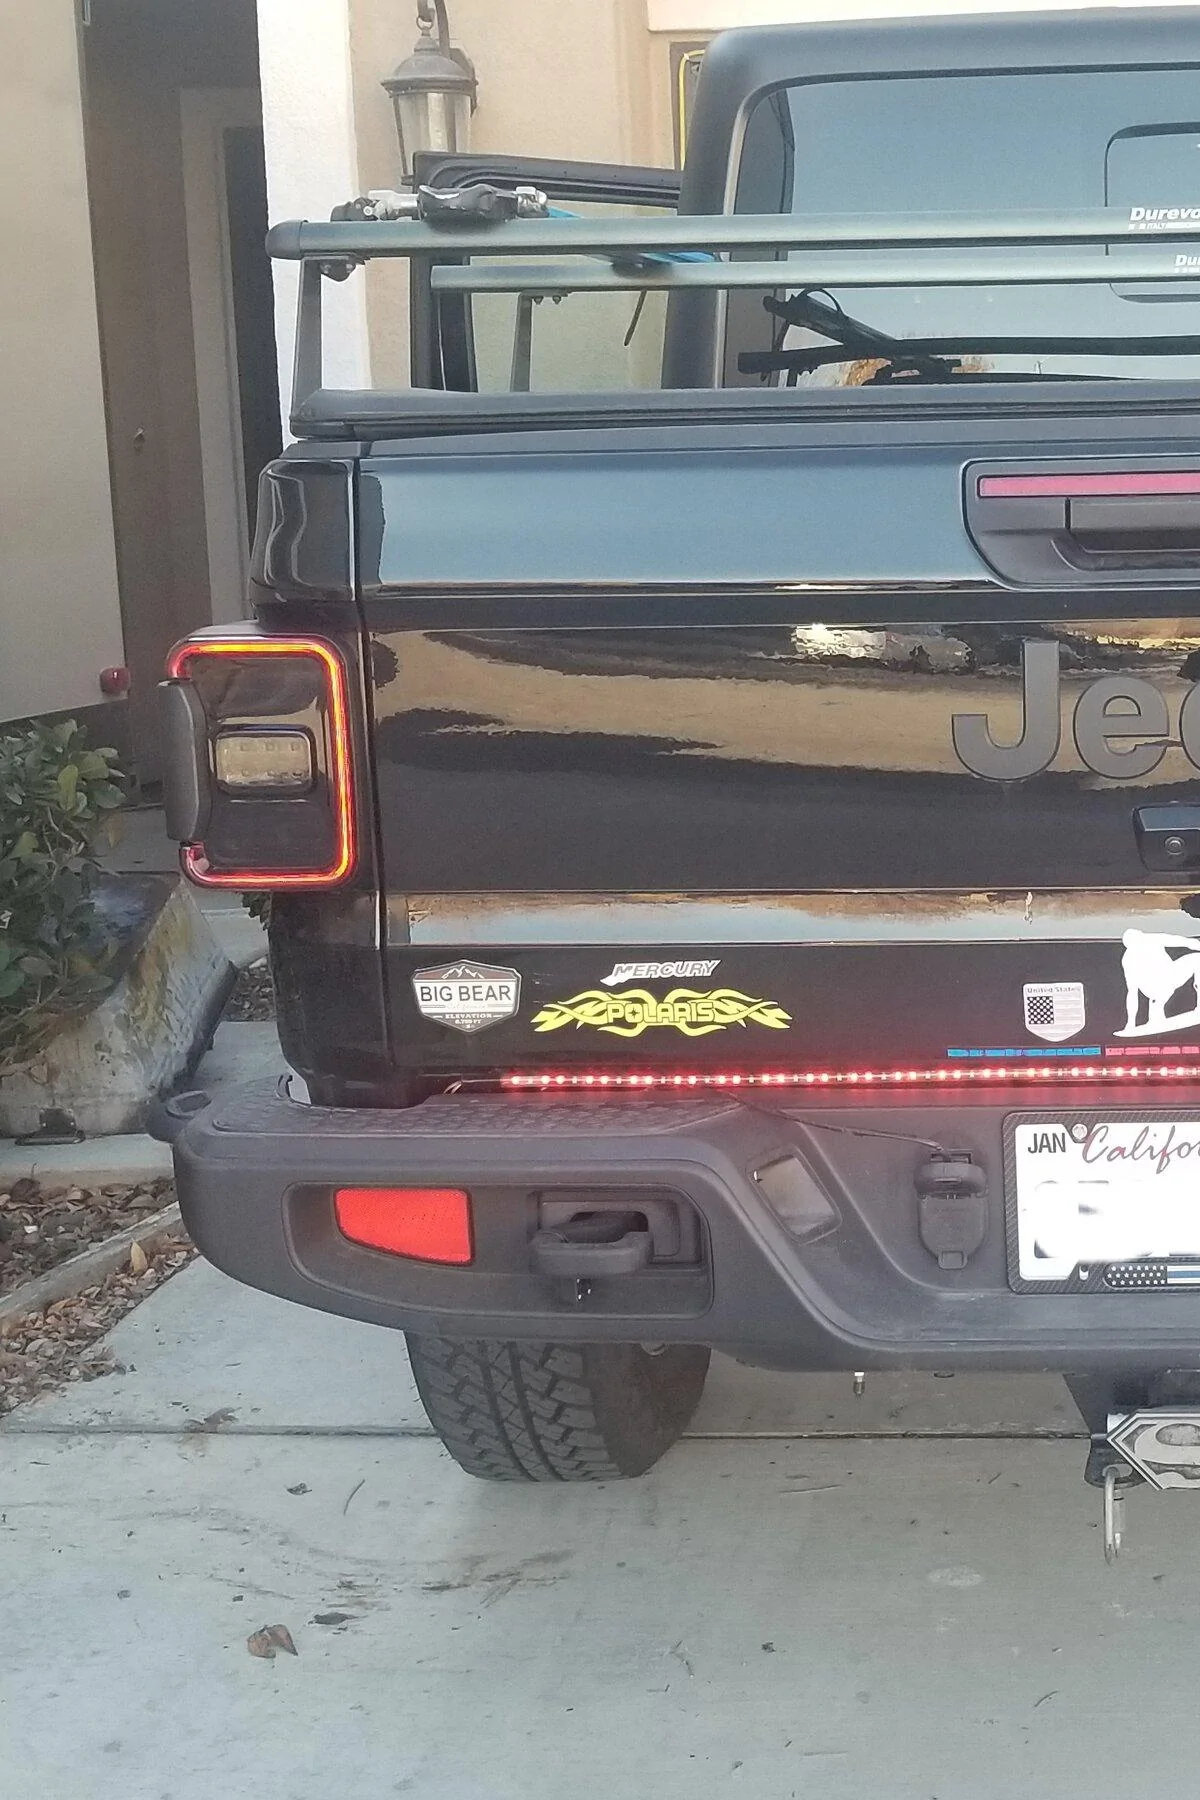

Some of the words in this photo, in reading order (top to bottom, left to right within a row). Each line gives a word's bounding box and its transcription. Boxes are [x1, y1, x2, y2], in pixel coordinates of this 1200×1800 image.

[605, 960, 721, 983] MERCURY
[420, 986, 453, 1002] BIG
[458, 985, 512, 1001] BEAR
[607, 1002, 716, 1023] POLARIS
[1027, 1132, 1066, 1154] JAN
